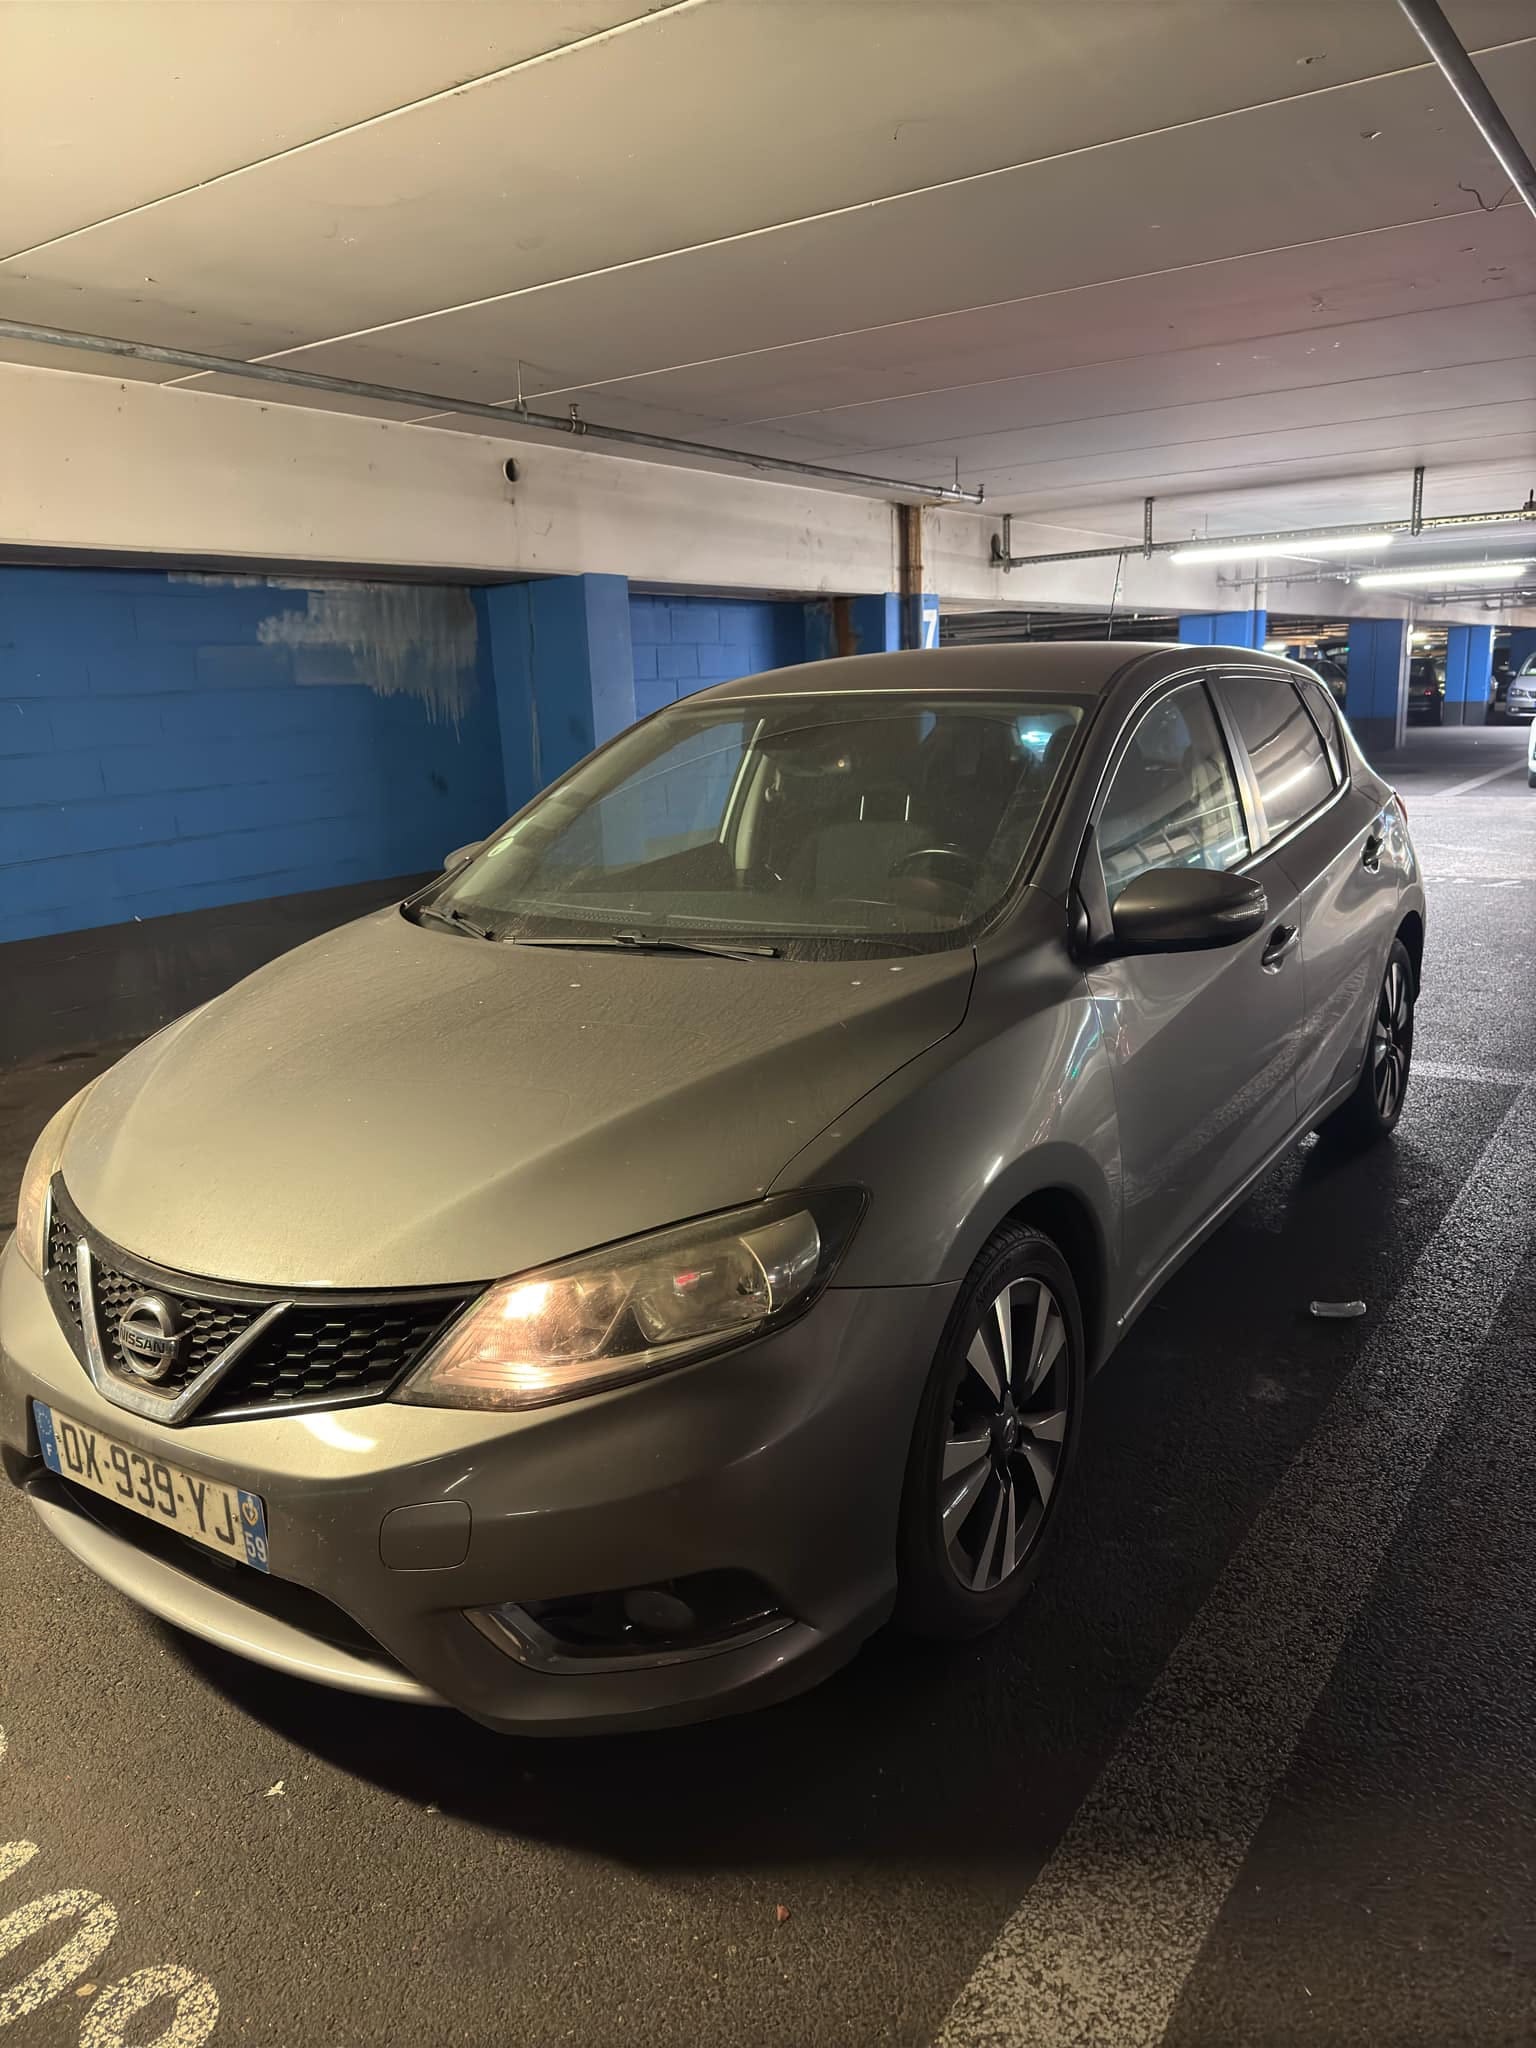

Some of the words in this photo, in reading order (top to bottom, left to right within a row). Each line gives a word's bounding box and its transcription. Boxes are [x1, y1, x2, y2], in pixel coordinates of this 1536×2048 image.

[119, 1326, 165, 1354] NISSAN
[46, 1443, 53, 1457] F
[60, 1420, 236, 1546] DX-939-YJ
[243, 1530, 268, 1563] 59
